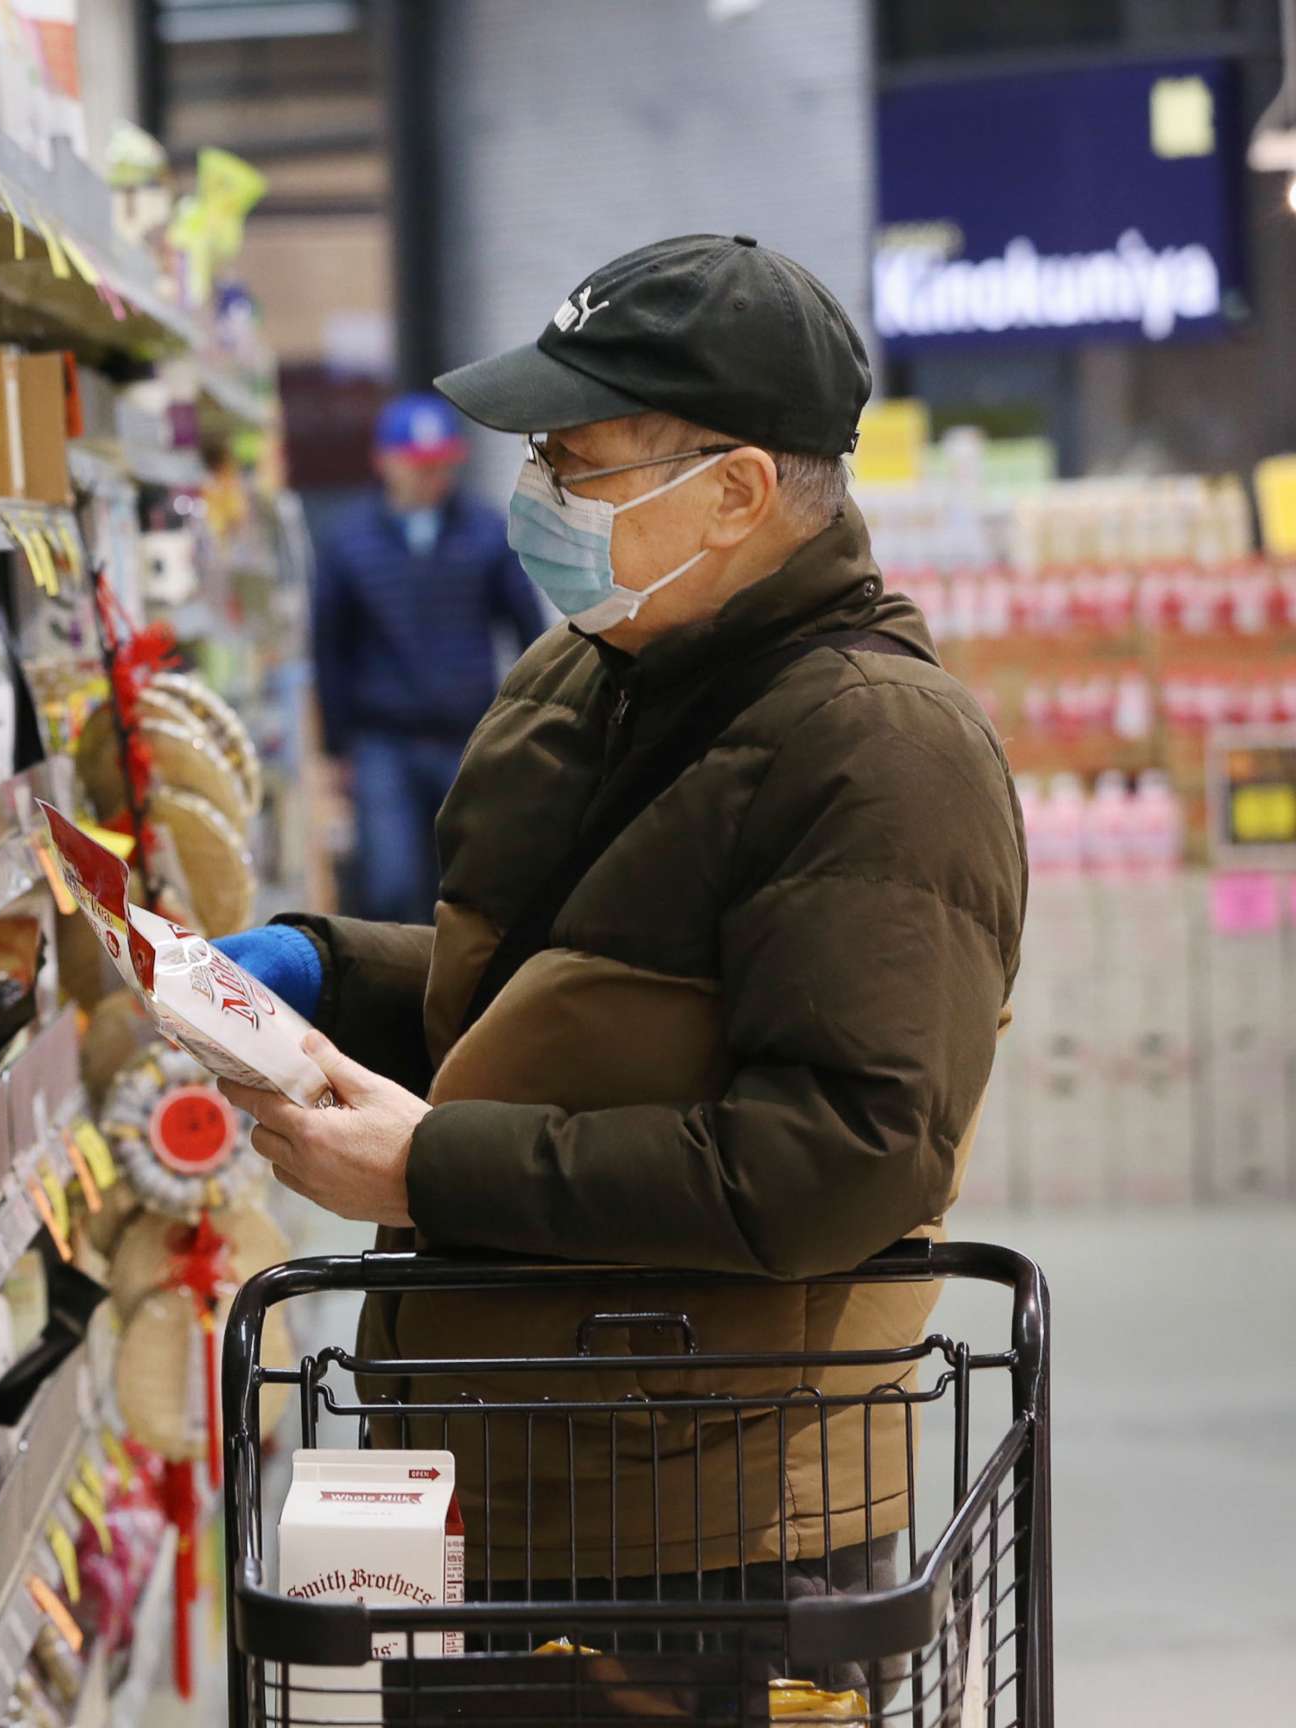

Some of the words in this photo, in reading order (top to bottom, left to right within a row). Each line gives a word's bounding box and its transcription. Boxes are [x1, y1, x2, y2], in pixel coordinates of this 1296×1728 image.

[411, 1470, 429, 1478] OPEN
[330, 1493, 378, 1502] Whole
[379, 1493, 412, 1503] Milk
[287, 1569, 347, 1600] Smith
[348, 1567, 436, 1605] Brothers
